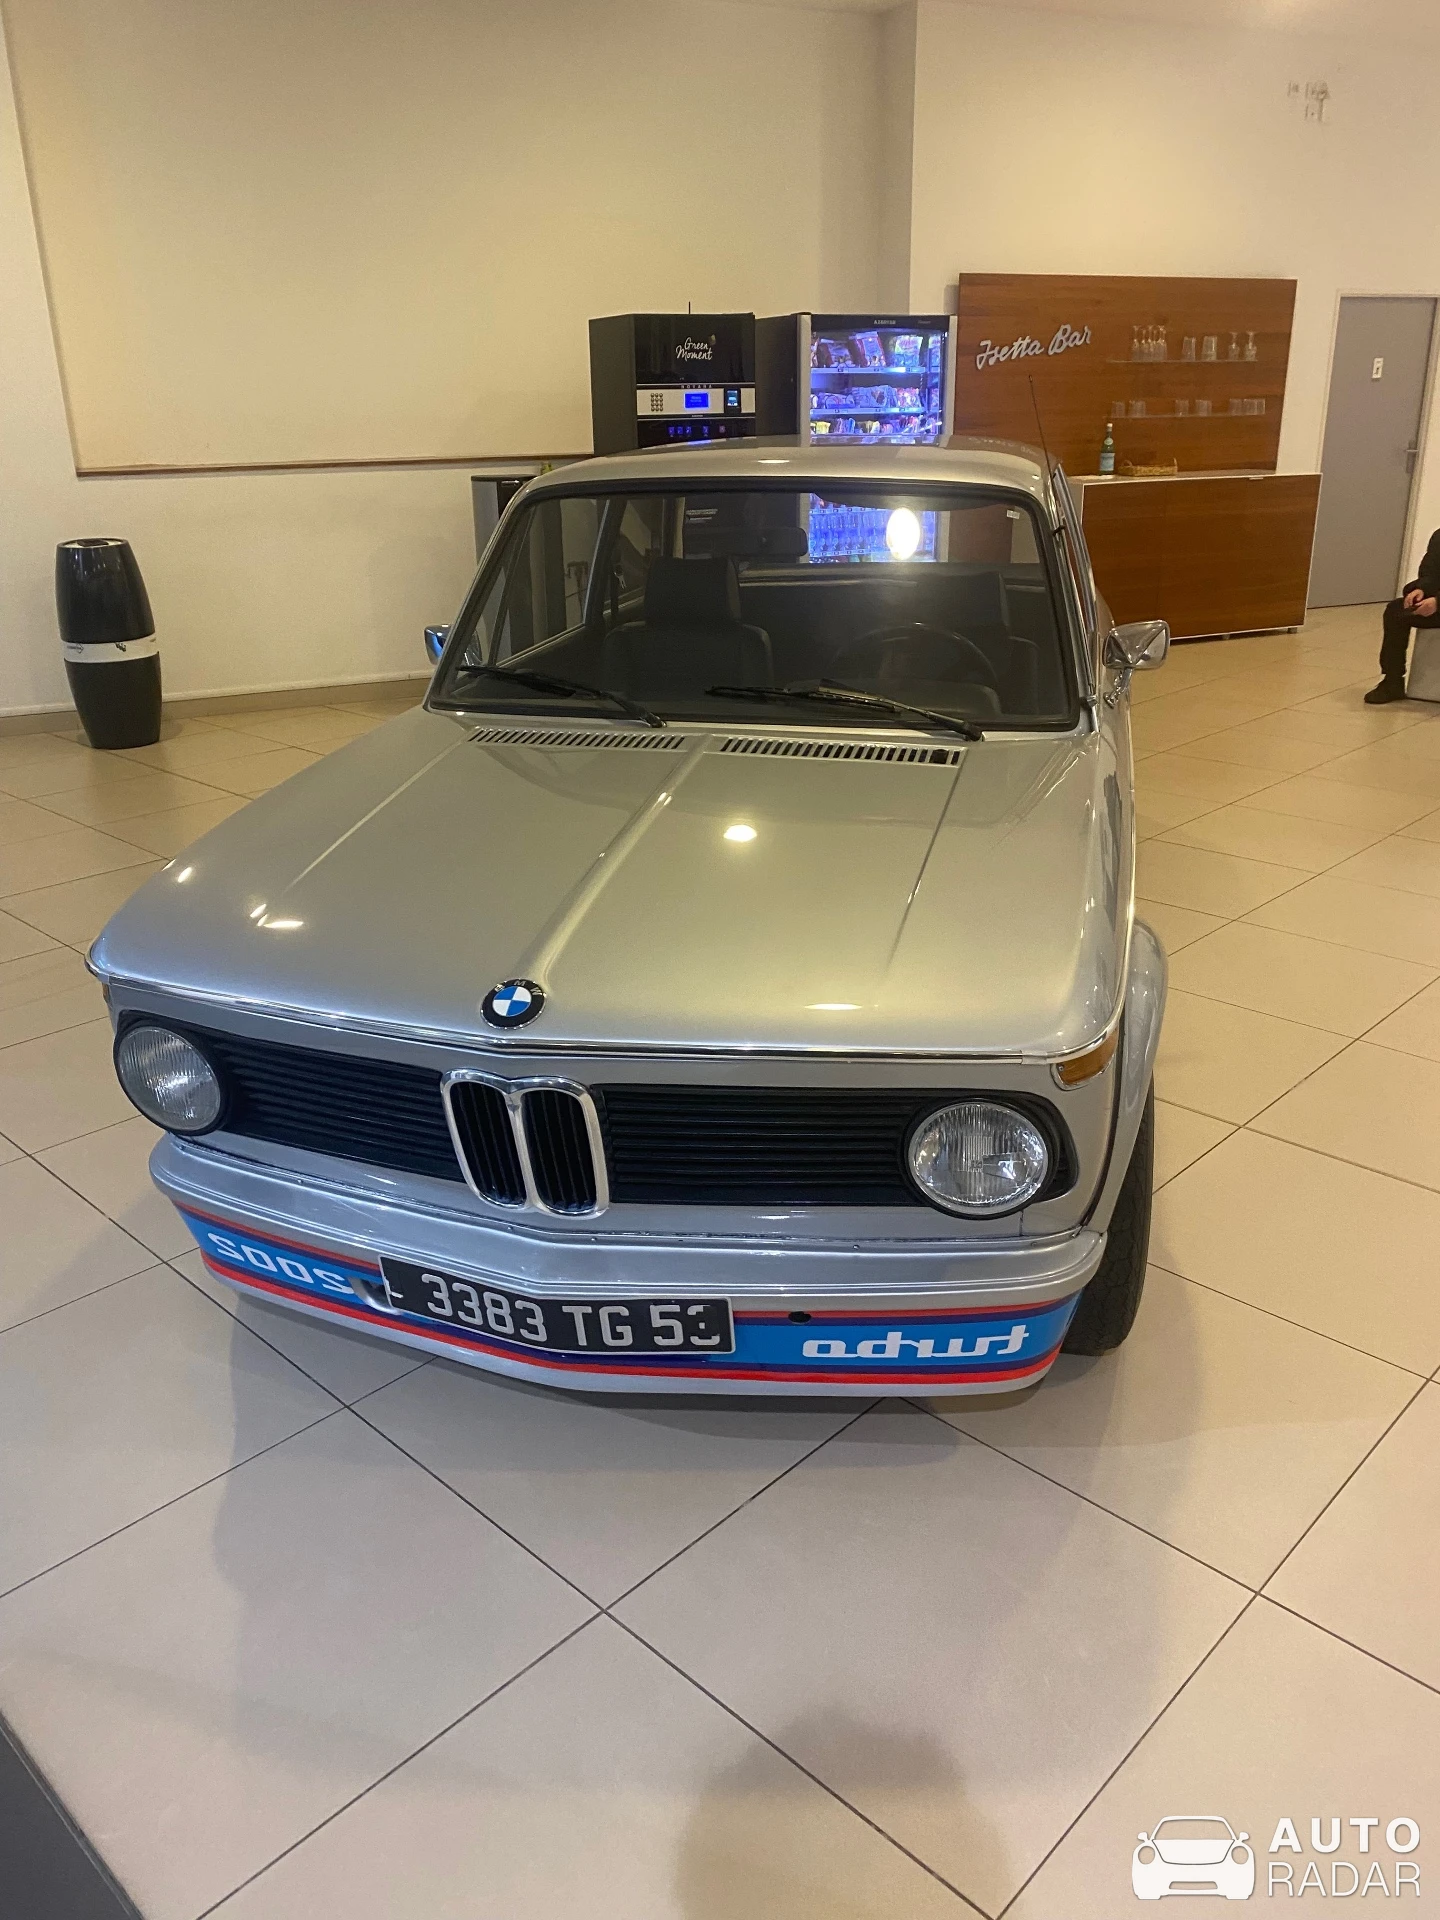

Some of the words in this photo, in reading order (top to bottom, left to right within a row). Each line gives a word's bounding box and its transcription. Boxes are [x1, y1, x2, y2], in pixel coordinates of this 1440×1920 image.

[685, 337, 708, 350] Green
[976, 335, 1045, 370] Isetta
[1048, 324, 1092, 356] Bar
[676, 346, 712, 361] Moment
[494, 980, 543, 996] BMW
[421, 1273, 548, 1343] 3383
[562, 1305, 633, 1347] TG
